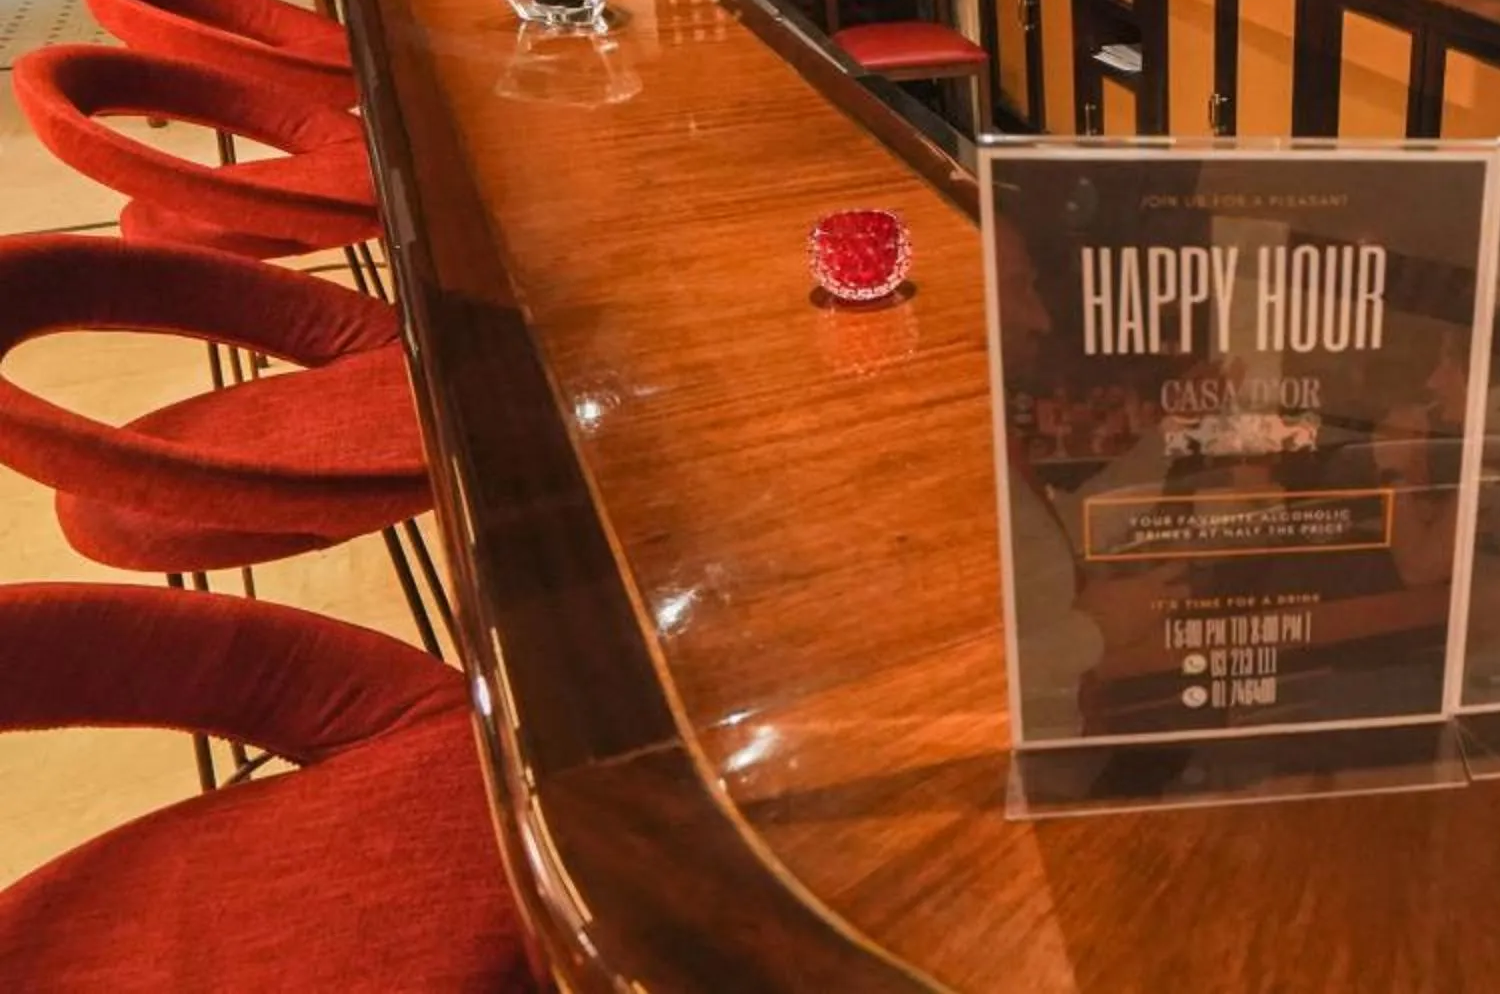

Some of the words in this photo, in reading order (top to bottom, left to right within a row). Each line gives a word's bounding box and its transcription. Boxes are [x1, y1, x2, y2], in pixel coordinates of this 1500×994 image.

[1081, 245, 1239, 356] HAPPY
[1257, 242, 1387, 353] HOUR
[1160, 380, 1237, 412] CASA
[1247, 377, 1322, 409] D'OR
[1129, 515, 1171, 527] YOUR
[1261, 508, 1351, 523] ALCOHOLIC
[1268, 524, 1294, 536] THE
[1206, 618, 1226, 646] PM
